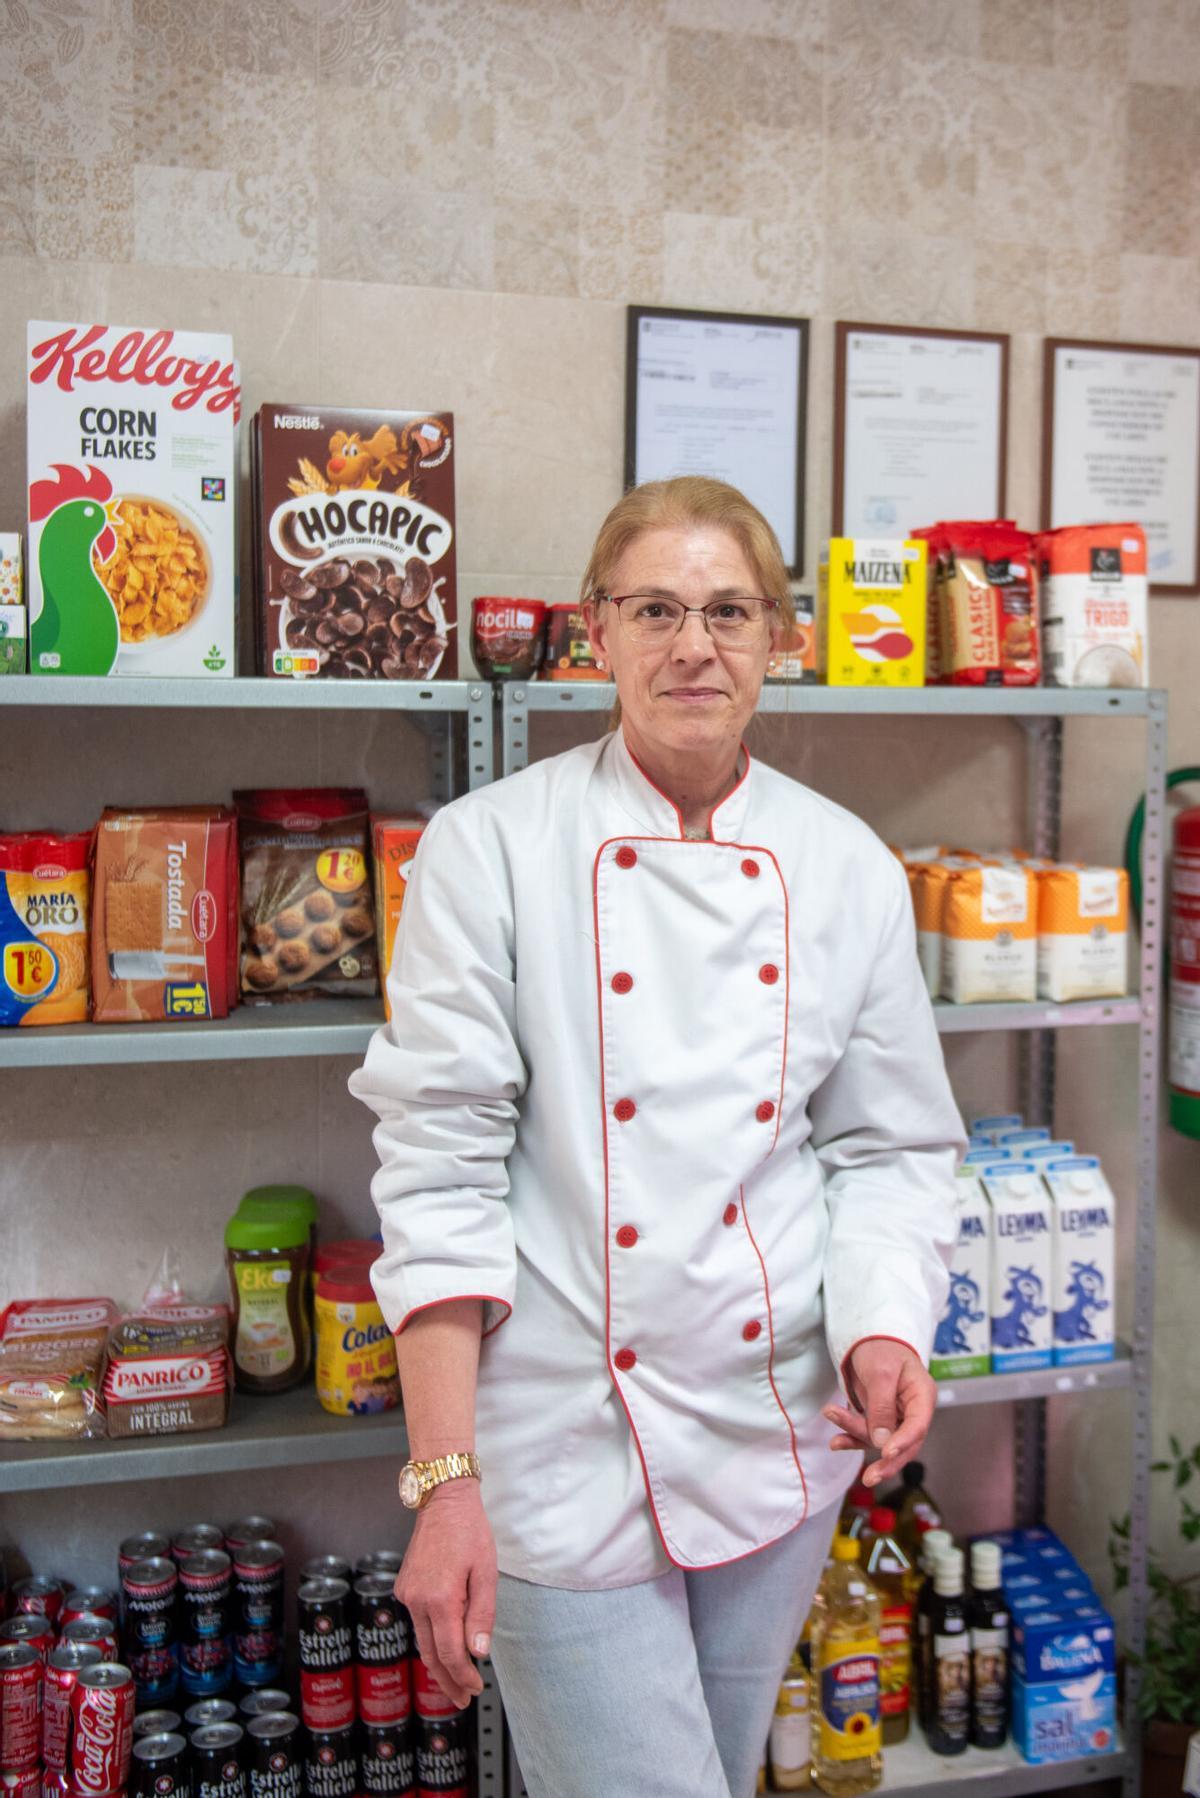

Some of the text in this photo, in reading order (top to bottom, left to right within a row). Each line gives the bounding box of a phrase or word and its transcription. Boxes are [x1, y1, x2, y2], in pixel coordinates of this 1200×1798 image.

[80, 407, 157, 437] CORN
[81, 438, 156, 461] FLAKES
[279, 500, 443, 560] CHOCAPIC
[843, 561, 911, 584] MAIZENA
[476, 608, 529, 629] nocil
[1085, 610, 1129, 628] TRIGO
[167, 840, 187, 929] Tostada
[27, 891, 76, 906] MARÍA
[25, 907, 79, 927] ORO
[342, 1323, 391, 1352] Cola
[118, 1366, 204, 1388] PANRICO
[130, 1409, 194, 1430] INTEGRAL
[1035, 1710, 1075, 1740] sal
